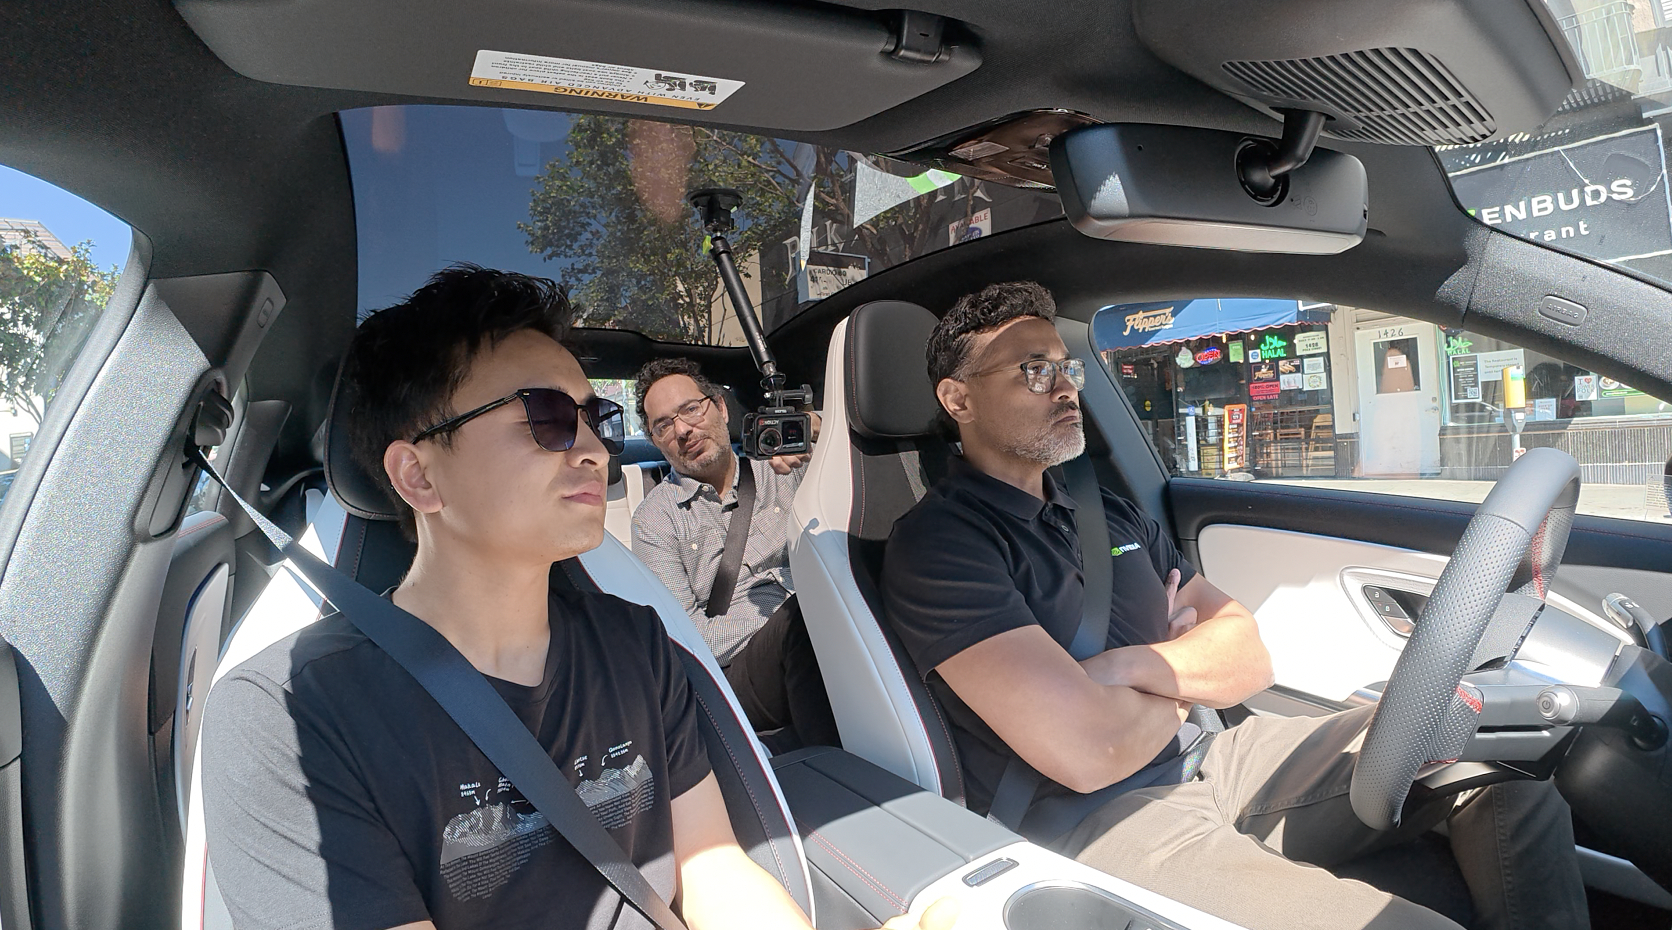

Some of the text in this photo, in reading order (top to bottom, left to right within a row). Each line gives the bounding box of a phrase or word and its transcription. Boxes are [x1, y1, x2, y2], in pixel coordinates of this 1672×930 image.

[552, 86, 649, 102] WARNING
[568, 82, 632, 94] ADVANCED
[1468, 179, 1634, 225] ENBUDS
[951, 212, 988, 234] AVAABLE
[1521, 220, 1590, 242] rant
[782, 220, 846, 285] PLK
[1546, 303, 1579, 318] AIRBAG
[1123, 306, 1174, 336] Flipper's
[1378, 328, 1404, 338] 1426
[1195, 350, 1221, 361] OPEN
[1262, 348, 1286, 358] HALAL
[1448, 348, 1471, 356] HALAL
[1119, 542, 1141, 553] NVIDIA
